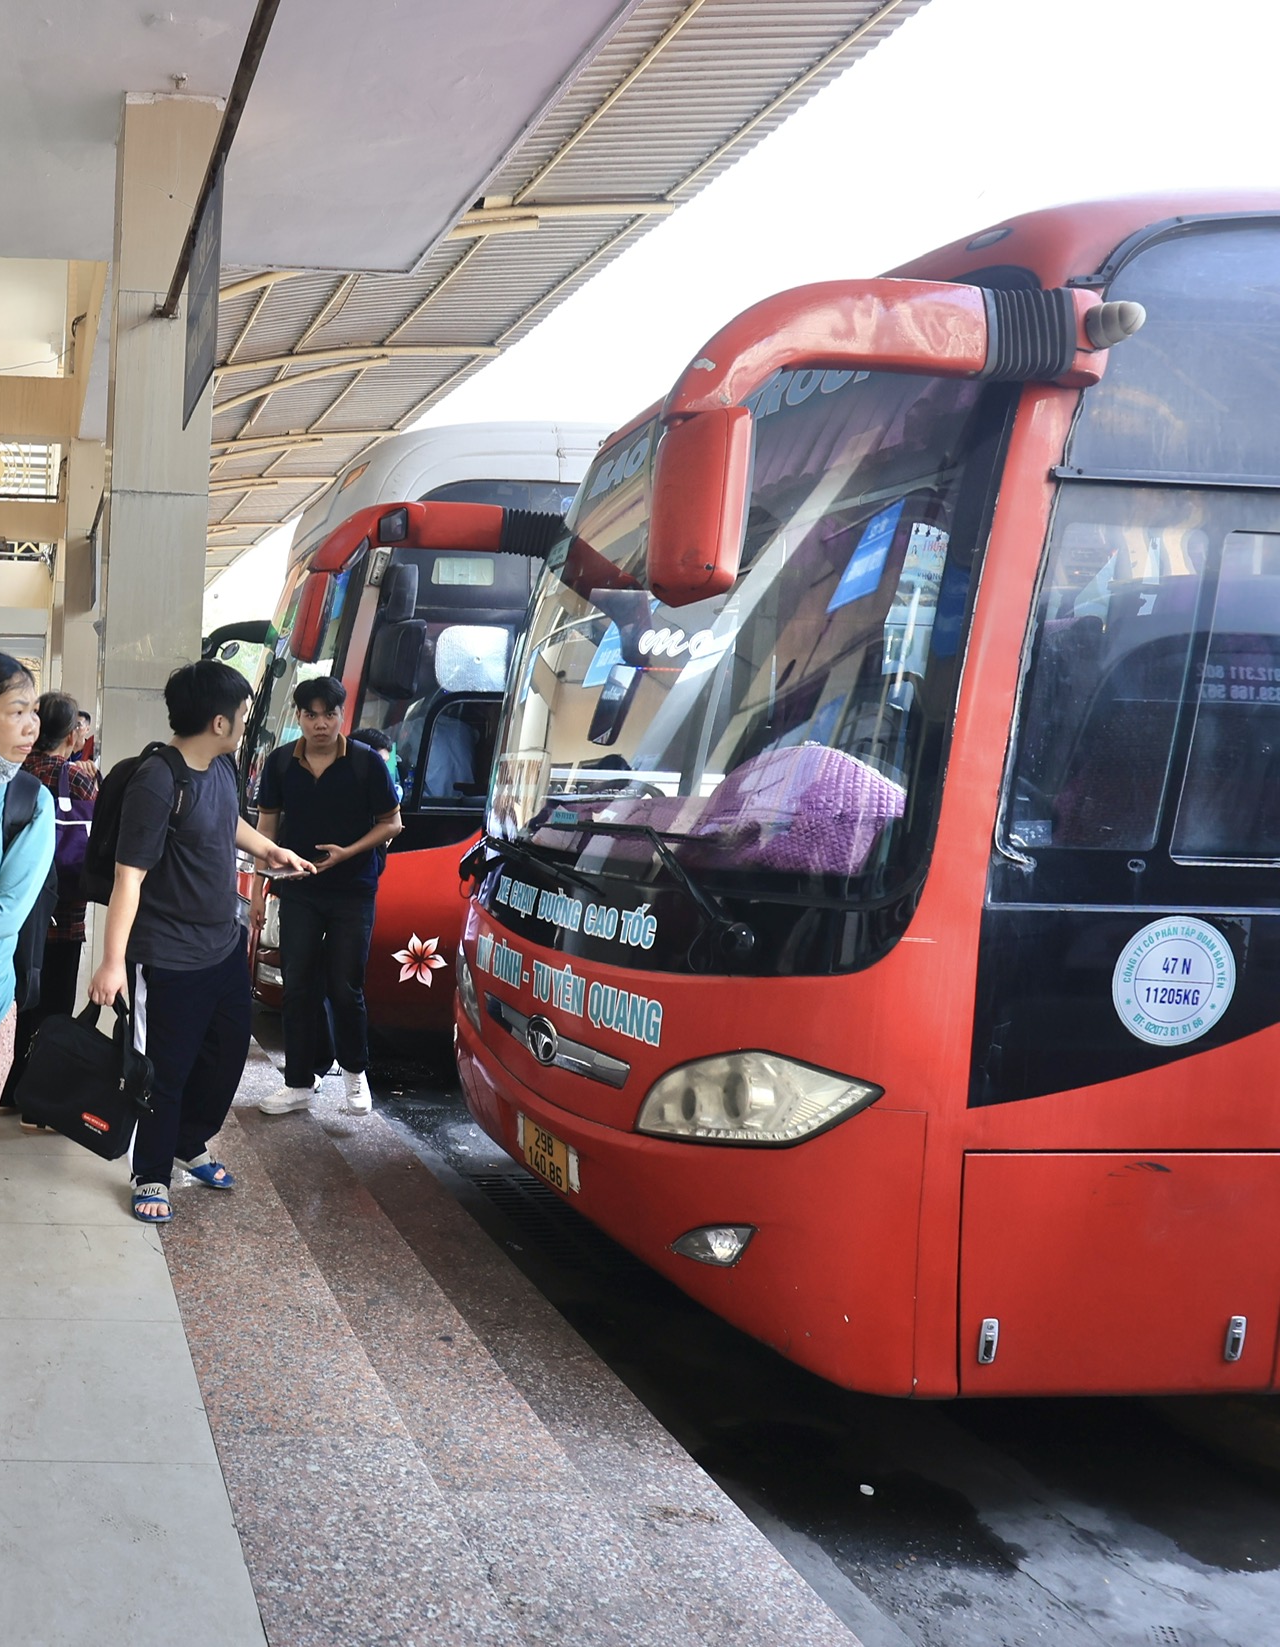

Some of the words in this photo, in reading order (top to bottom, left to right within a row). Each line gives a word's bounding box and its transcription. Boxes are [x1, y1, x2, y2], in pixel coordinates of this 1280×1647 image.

[496, 874, 511, 905] XE
[509, 877, 538, 918] CHẠY
[537, 887, 583, 932] ĐƯỜNG
[584, 903, 619, 941] CAO
[619, 903, 658, 950] TỐC
[1142, 932, 1155, 949] CỔ
[1155, 926, 1179, 941] PHẦN
[1181, 926, 1196, 938] TẬP
[1134, 945, 1144, 958] TY
[1196, 932, 1217, 952] ĐOÀN
[1162, 957, 1179, 975] 47
[1181, 958, 1192, 975] N
[1212, 950, 1225, 969] BẢO
[1123, 957, 1138, 983] CÔNG
[1216, 970, 1228, 989] YÊN
[476, 932, 493, 973] MỸ
[493, 938, 523, 990] ĐÌNH
[533, 959, 586, 1018] TUYÊN
[588, 981, 663, 1048] QUANG
[1145, 986, 1201, 1006] 11205KG
[1133, 1013, 1146, 1027] ĐT:
[1144, 1021, 1169, 1037] 02073
[1170, 1026, 1179, 1037] 81
[1182, 1023, 1191, 1034] 81
[534, 1127, 554, 1157] 29B
[528, 1146, 563, 1188] 140.86
[141, 1186, 161, 1196] NIKE
